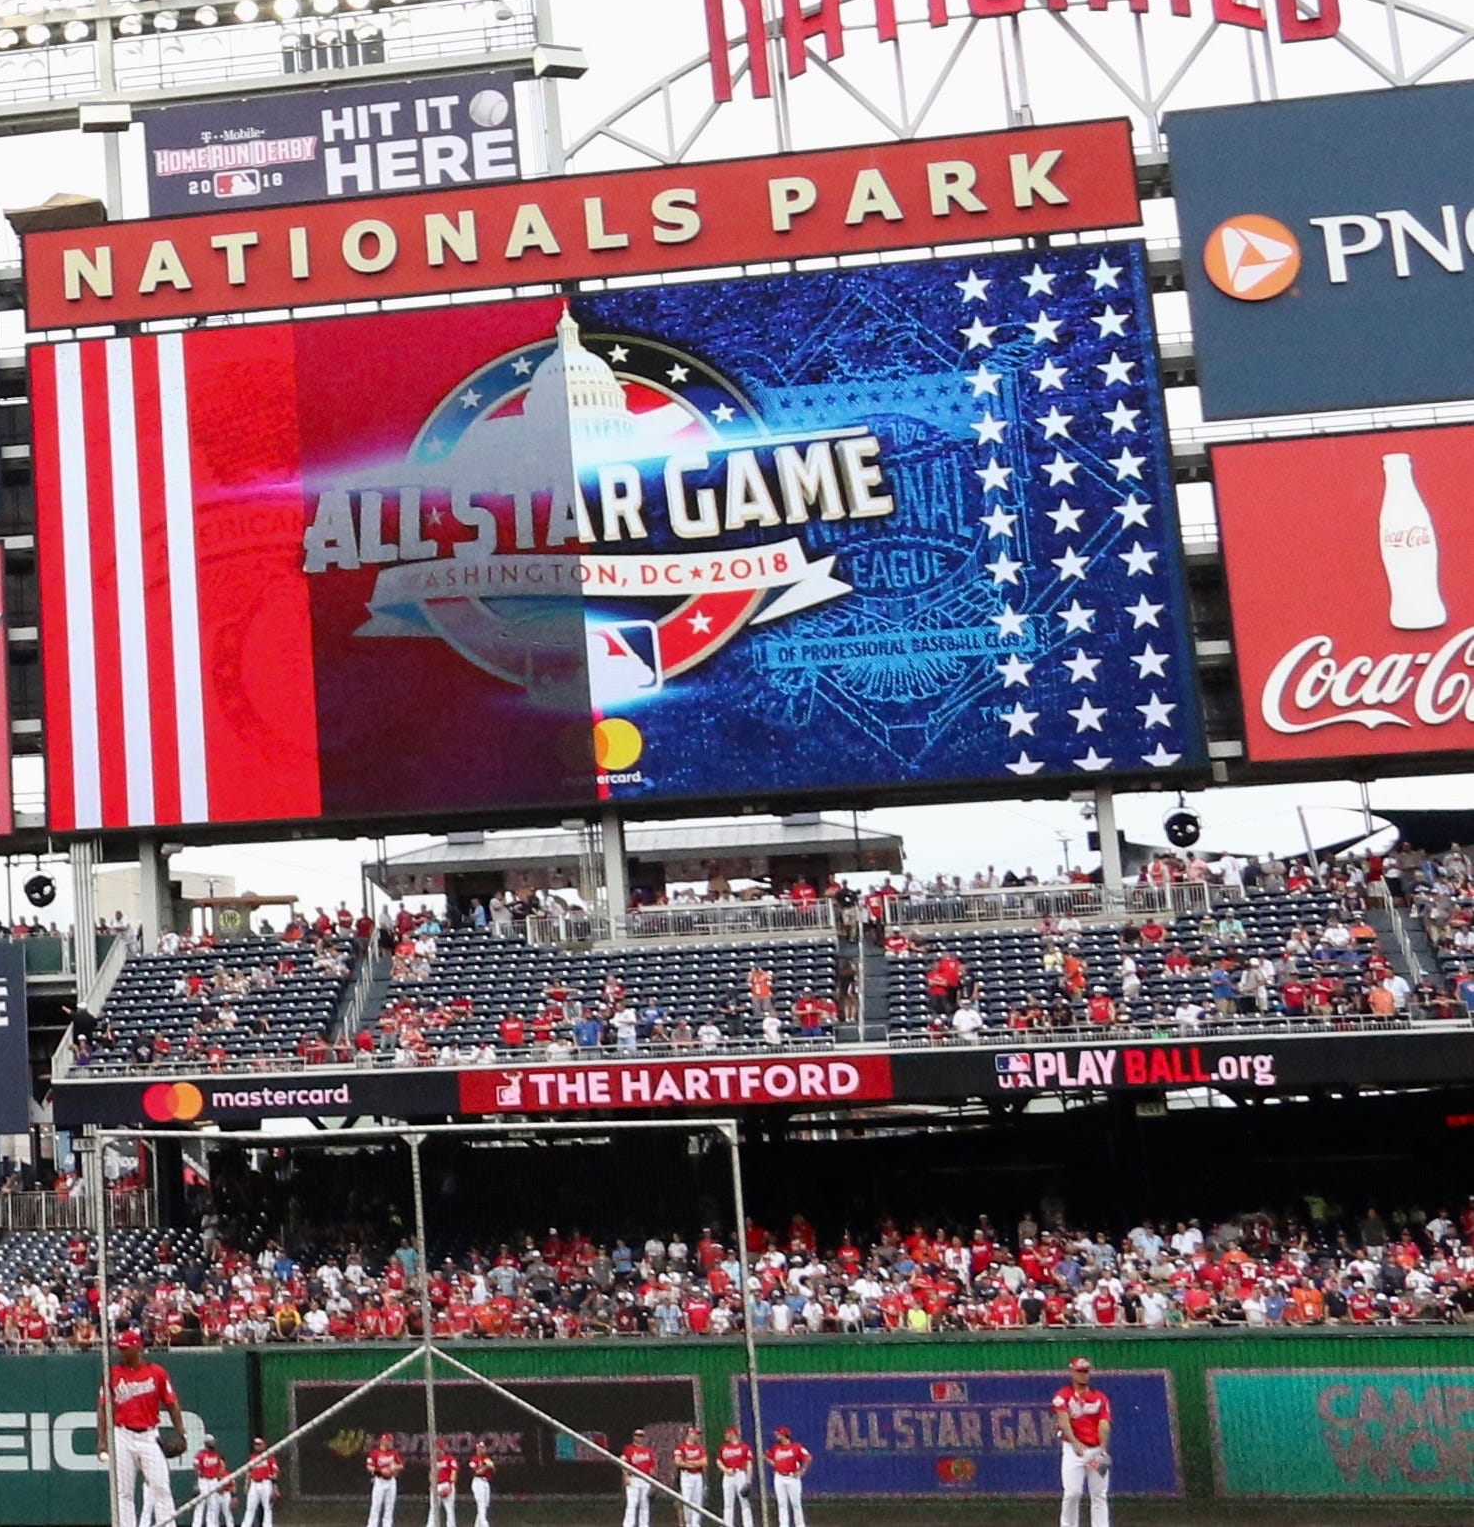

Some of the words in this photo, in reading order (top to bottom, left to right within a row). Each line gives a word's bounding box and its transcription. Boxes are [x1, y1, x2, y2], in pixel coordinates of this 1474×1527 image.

[322, 102, 401, 142] HIT
[415, 95, 459, 132] IT
[155, 146, 209, 176] HOME
[209, 141, 254, 170] RUN
[254, 135, 318, 165] DERBY
[325, 129, 517, 195] HERE
[188, 178, 211, 196] 20
[262, 172, 283, 188] 18
[63, 188, 702, 302] NATIONALS
[768, 149, 1071, 234] PARK
[304, 486, 437, 573] ALL
[451, 461, 650, 564] STAR
[668, 436, 895, 540] GAME
[639, 562, 685, 588] DC
[710, 550, 791, 583] 2018
[851, 548, 949, 590] EAGUE
[528, 1070, 611, 1106] THE
[621, 1062, 860, 1104] HARTFORD
[1033, 1049, 1117, 1087] PLAY
[1123, 1045, 1277, 1087] BALL.org
[212, 1082, 349, 1108] mastercard
[826, 1409, 888, 1451] ALL
[893, 1408, 984, 1450] STAR
